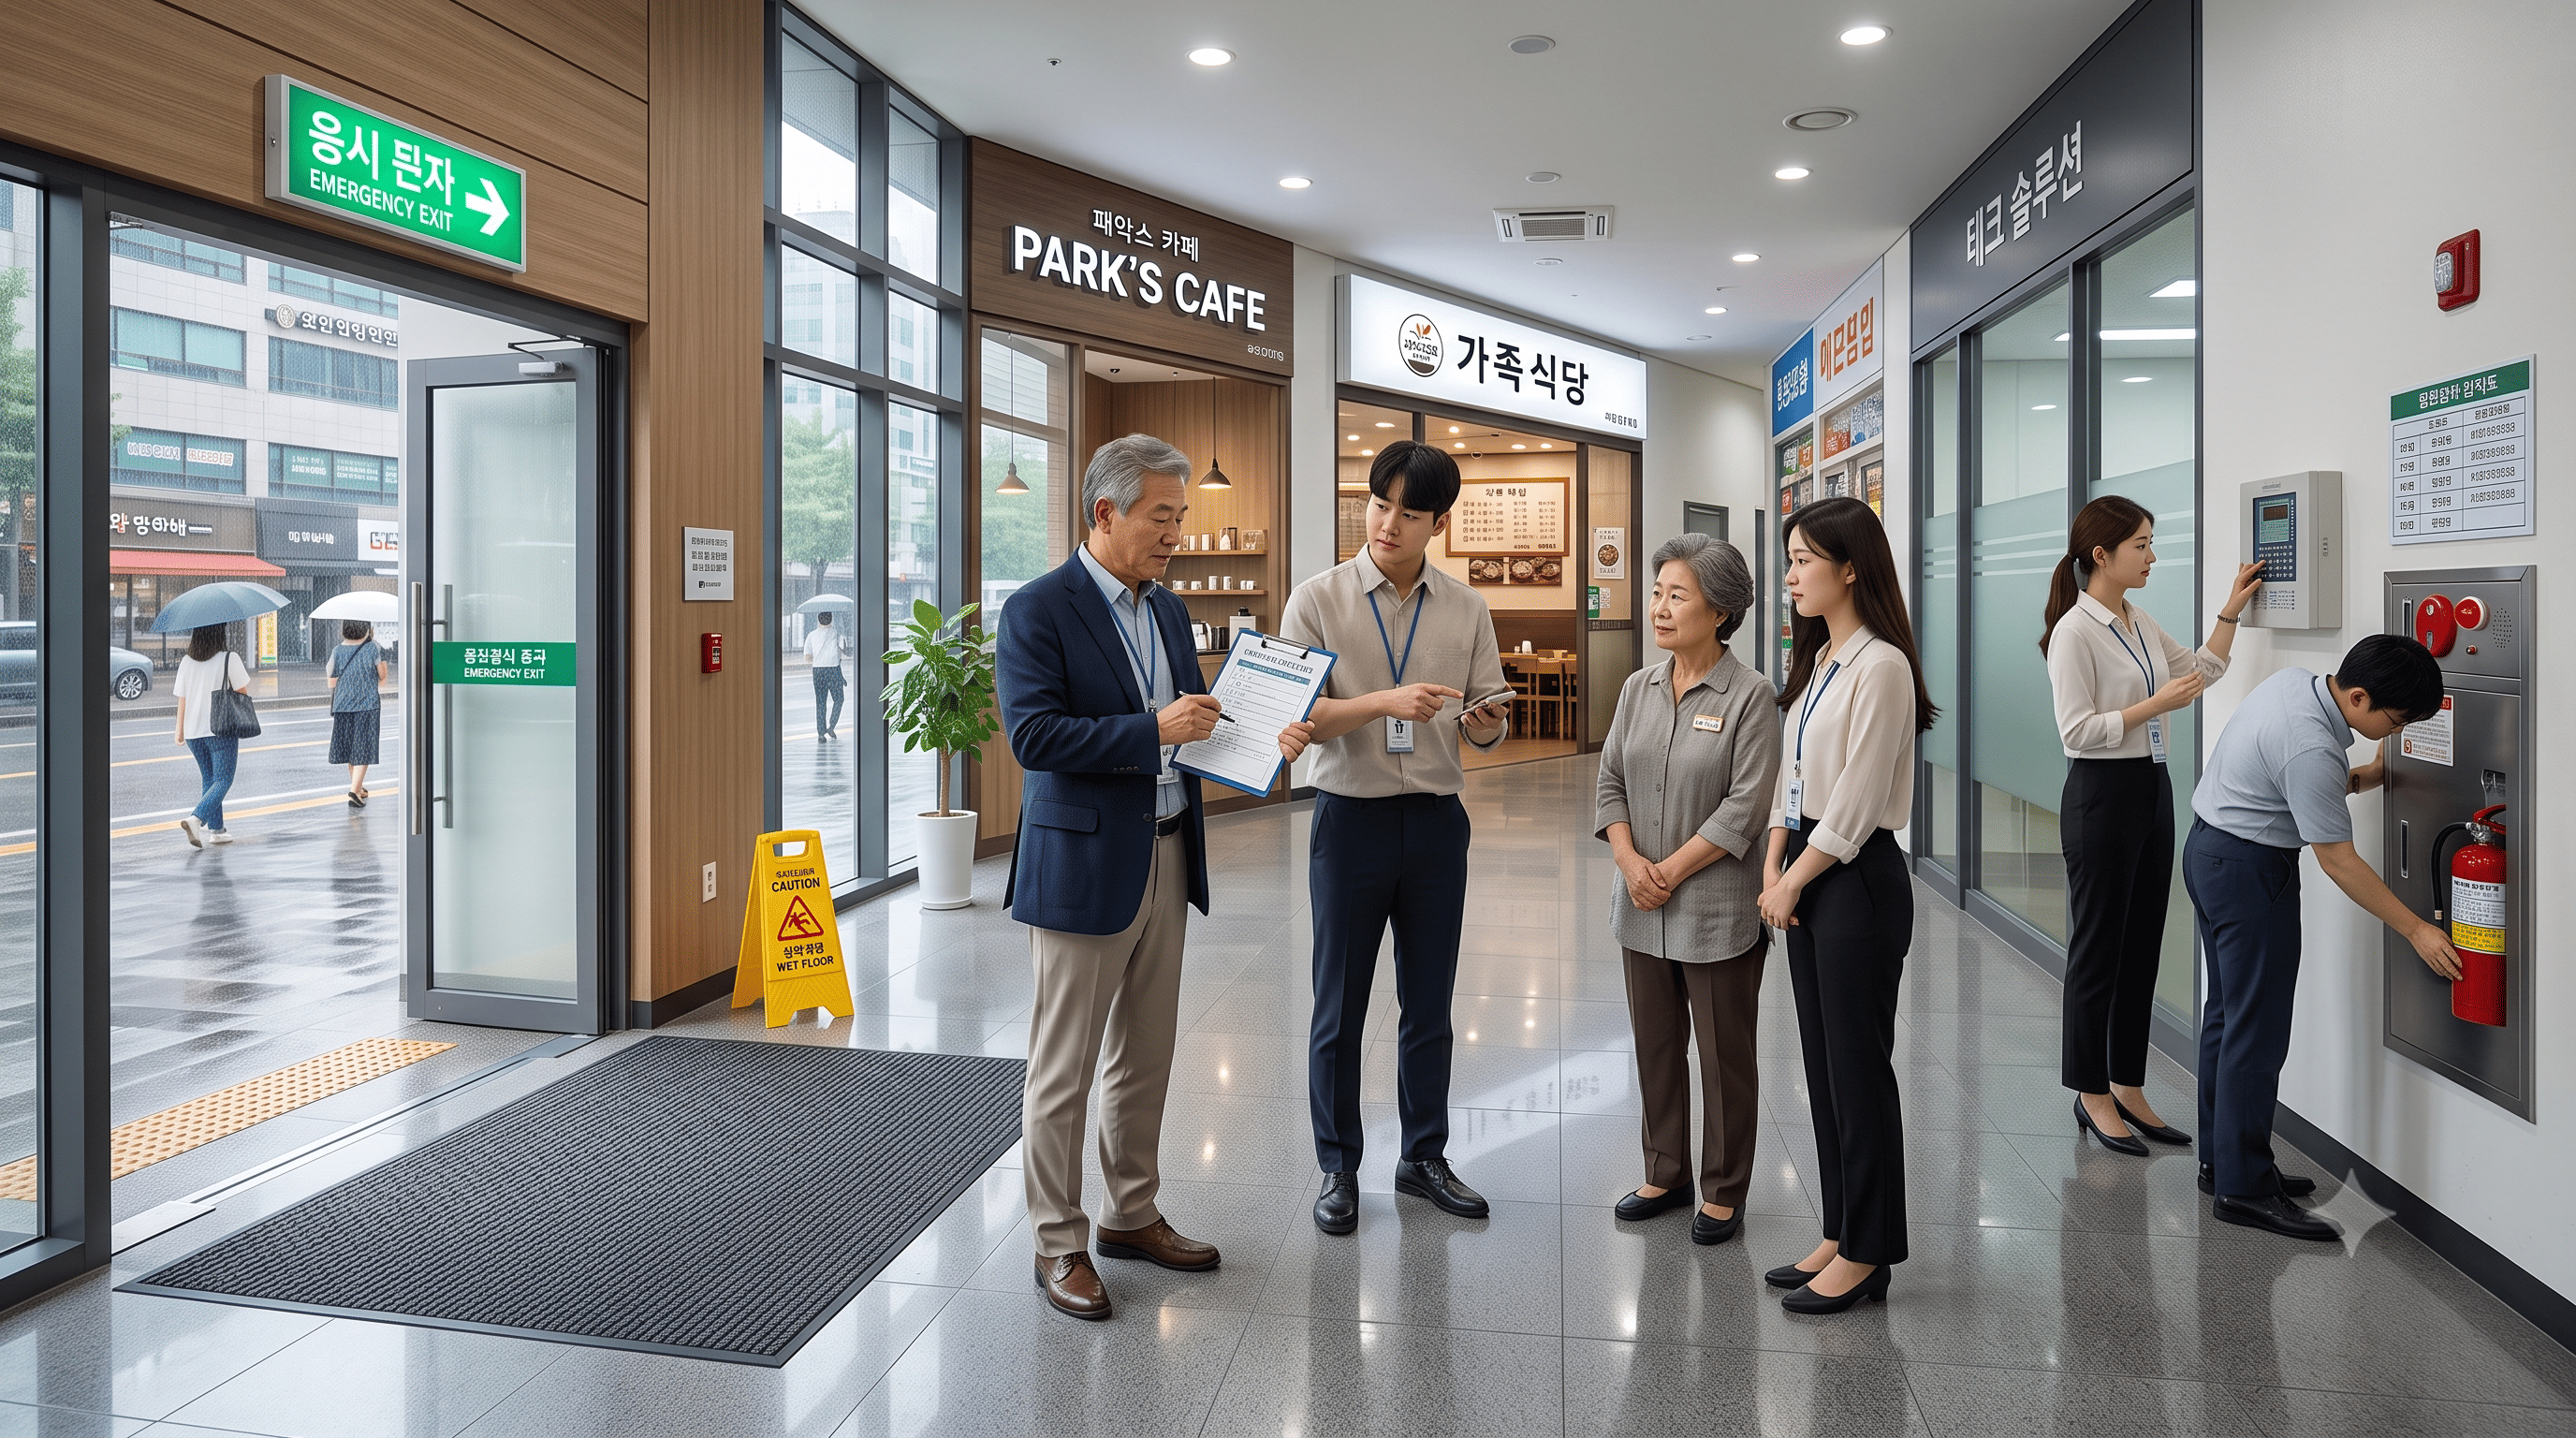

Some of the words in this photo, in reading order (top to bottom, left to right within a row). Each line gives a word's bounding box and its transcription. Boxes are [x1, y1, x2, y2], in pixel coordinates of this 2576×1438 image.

[308, 110, 379, 181] 응시
[309, 168, 415, 220] EMERGENCY
[419, 203, 454, 232] EXIT
[1967, 193, 2005, 268] 테크
[2010, 119, 2084, 242] 솔루션
[1092, 209, 1154, 248] 패악스
[1162, 229, 1199, 263] 카페
[1013, 225, 1164, 304] PARK'S
[1174, 271, 1266, 331] CAFE
[1456, 334, 1589, 406] 가족식당
[464, 668, 521, 679] EMERGENCY
[523, 668, 546, 680] EXIT
[771, 877, 821, 892] CAUTION
[776, 960, 799, 973] WET
[801, 956, 834, 969] FLOOR
